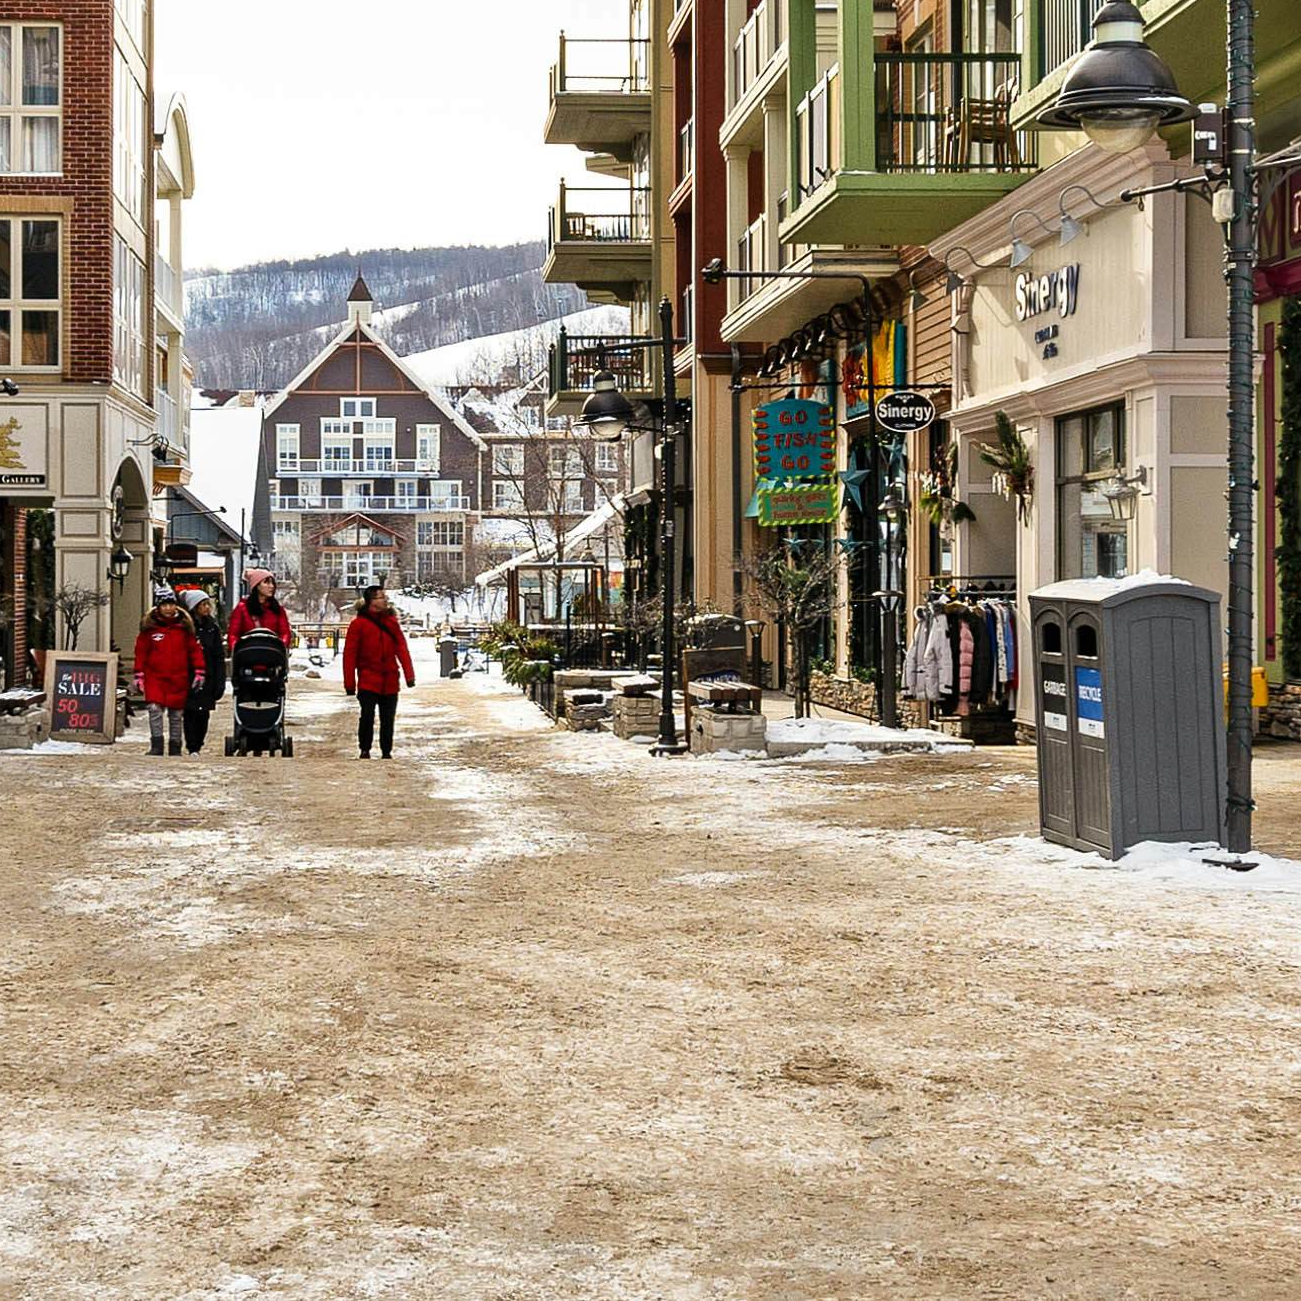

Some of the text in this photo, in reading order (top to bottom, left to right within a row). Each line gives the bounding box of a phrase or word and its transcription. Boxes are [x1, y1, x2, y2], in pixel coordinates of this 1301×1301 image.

[1015, 262, 1080, 322] Sinergy
[779, 410, 808, 426] GO
[878, 402, 932, 422] Sinergy
[773, 432, 819, 449] FISH
[781, 455, 810, 470] GO
[59, 682, 101, 696] SALE
[59, 699, 78, 713] 50
